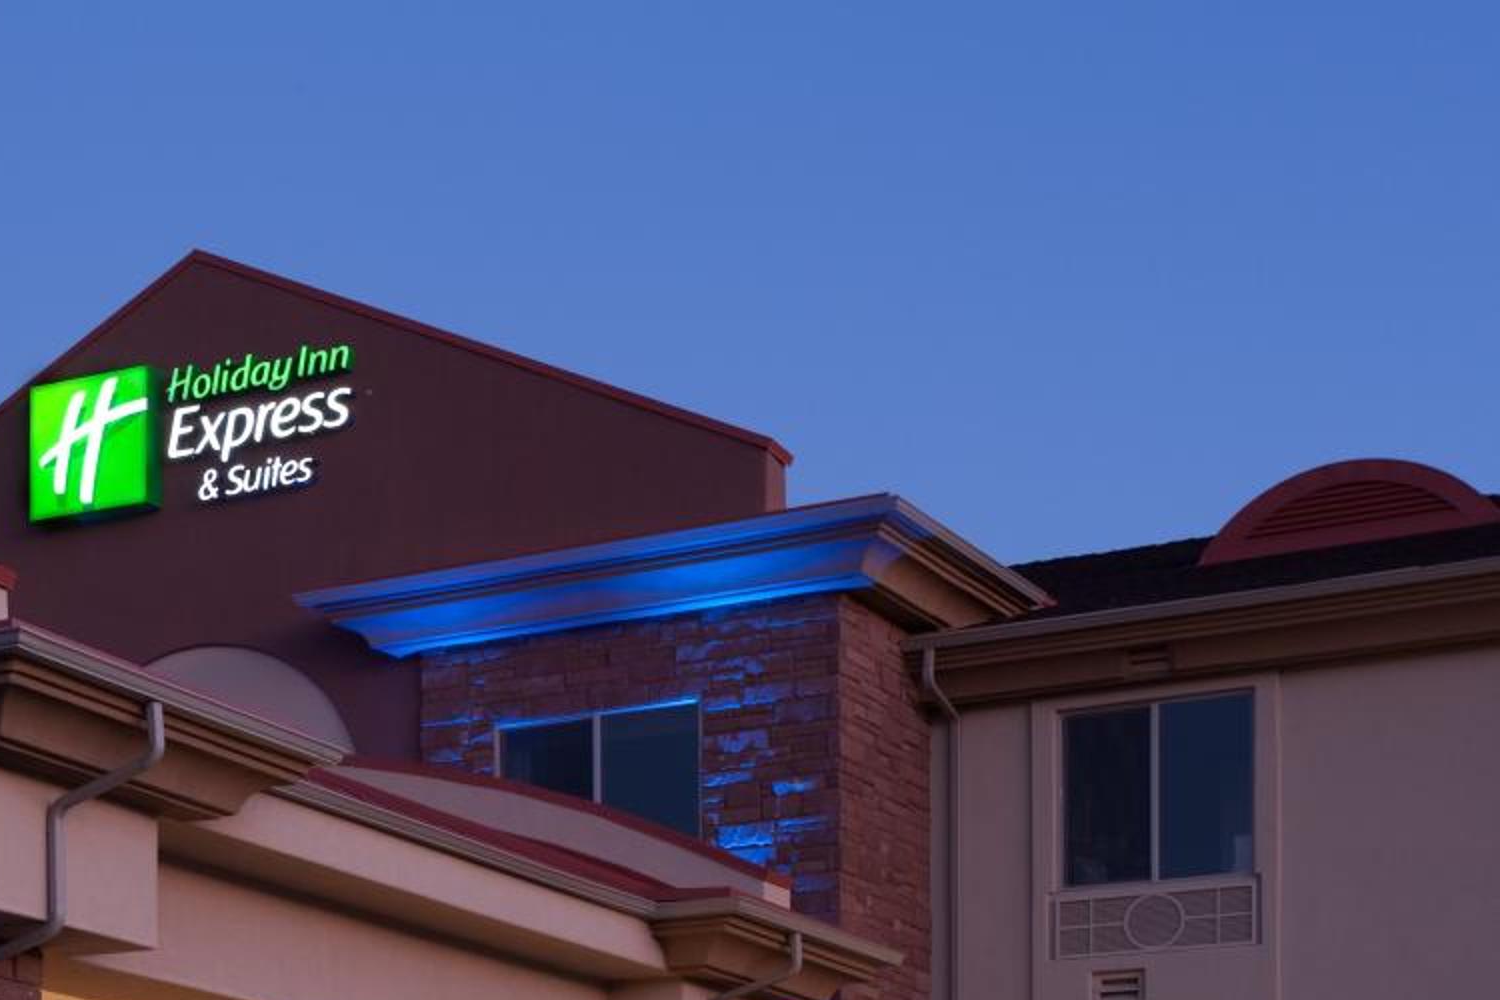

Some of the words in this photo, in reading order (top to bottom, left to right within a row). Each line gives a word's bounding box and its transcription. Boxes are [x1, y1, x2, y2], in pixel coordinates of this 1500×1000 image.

[167, 353, 293, 402] Holiday
[297, 345, 350, 376] Inn
[167, 387, 352, 462] Express
[198, 468, 219, 501] &
[225, 456, 313, 496] Suites
